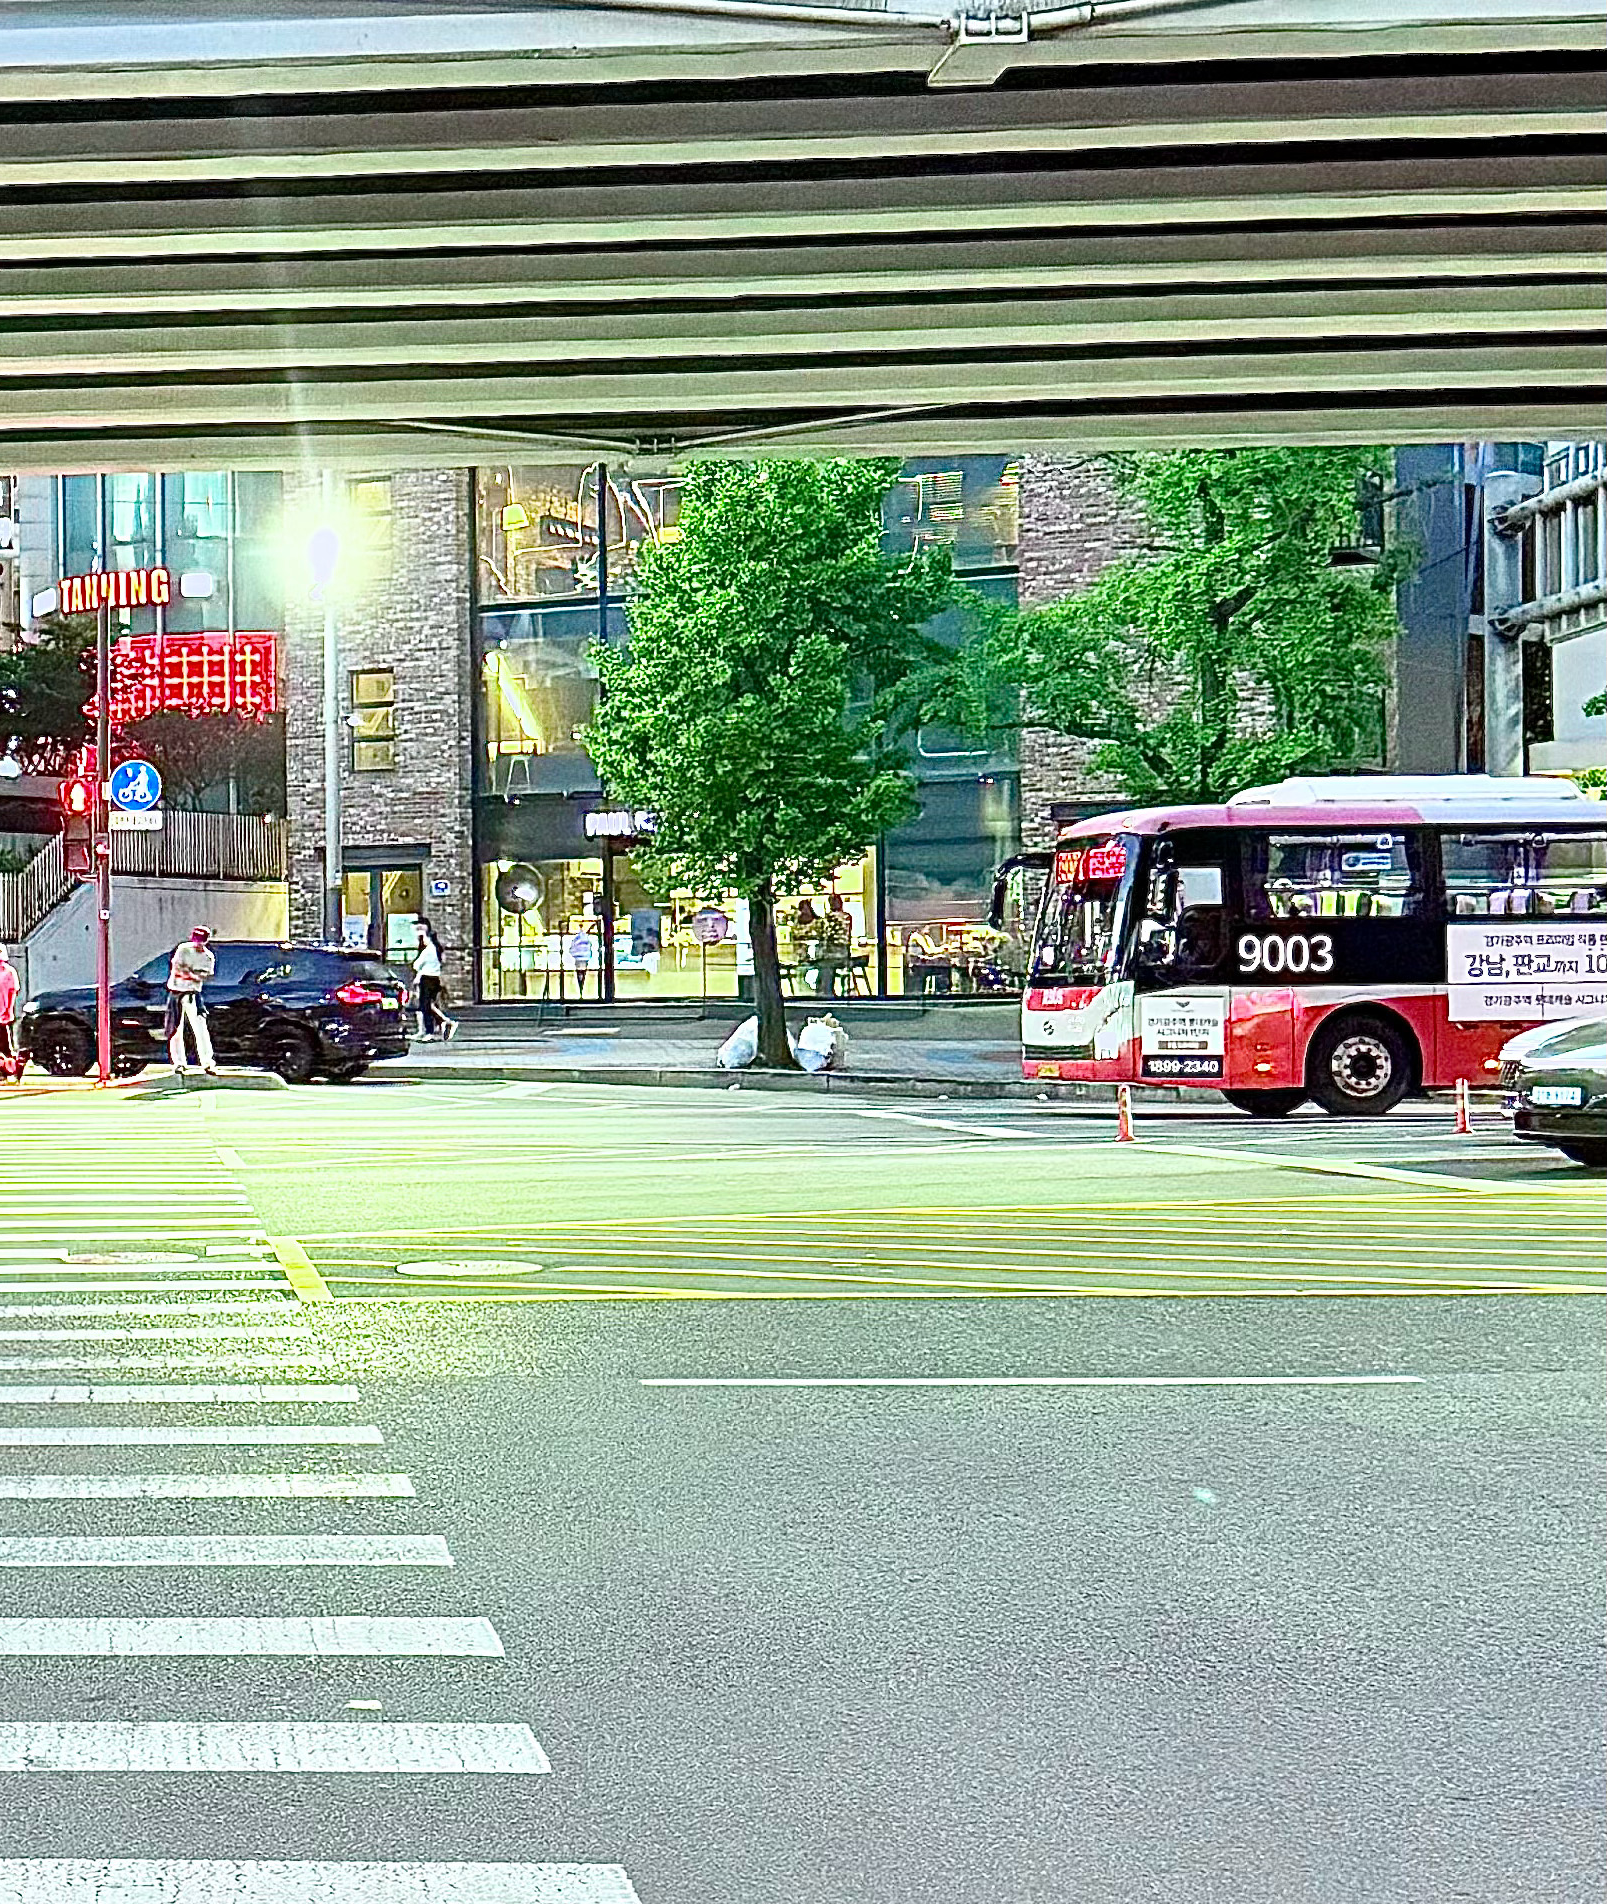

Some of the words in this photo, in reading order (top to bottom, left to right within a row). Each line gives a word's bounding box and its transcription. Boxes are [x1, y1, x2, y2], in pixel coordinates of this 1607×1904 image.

[60, 568, 169, 614] TANNING
[1238, 934, 1334, 973] 9003
[1464, 953, 1510, 979] 강남,
[1512, 953, 1579, 977] 판교까지
